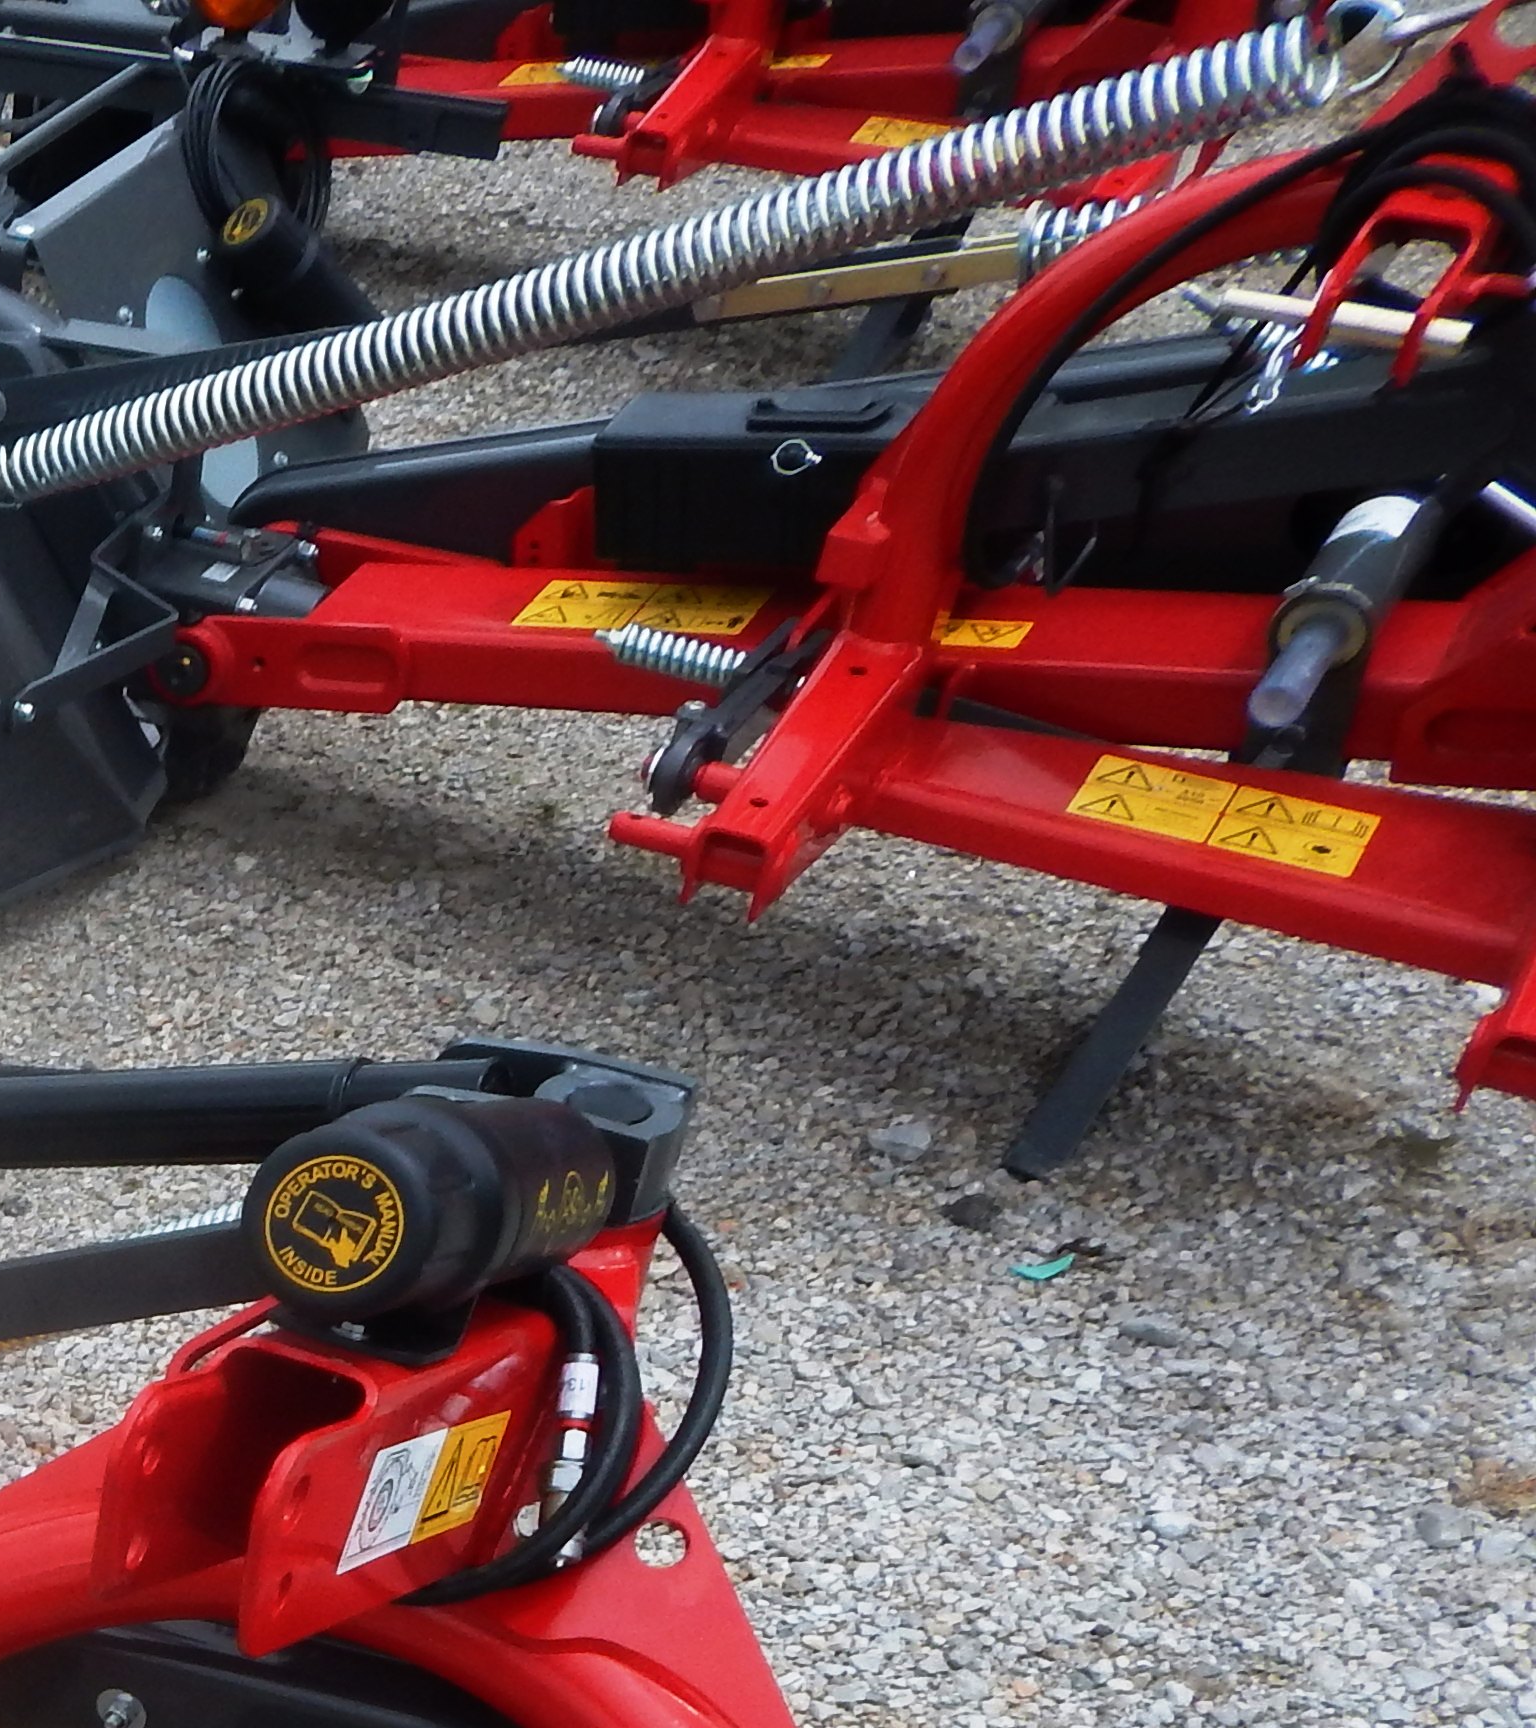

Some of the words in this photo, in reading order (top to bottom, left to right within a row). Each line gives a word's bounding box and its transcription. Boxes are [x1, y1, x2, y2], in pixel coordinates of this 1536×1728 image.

[274, 1162, 377, 1218] OPERATOR'S
[362, 1191, 398, 1266] MANUAL
[279, 1245, 338, 1286] INSIDE
